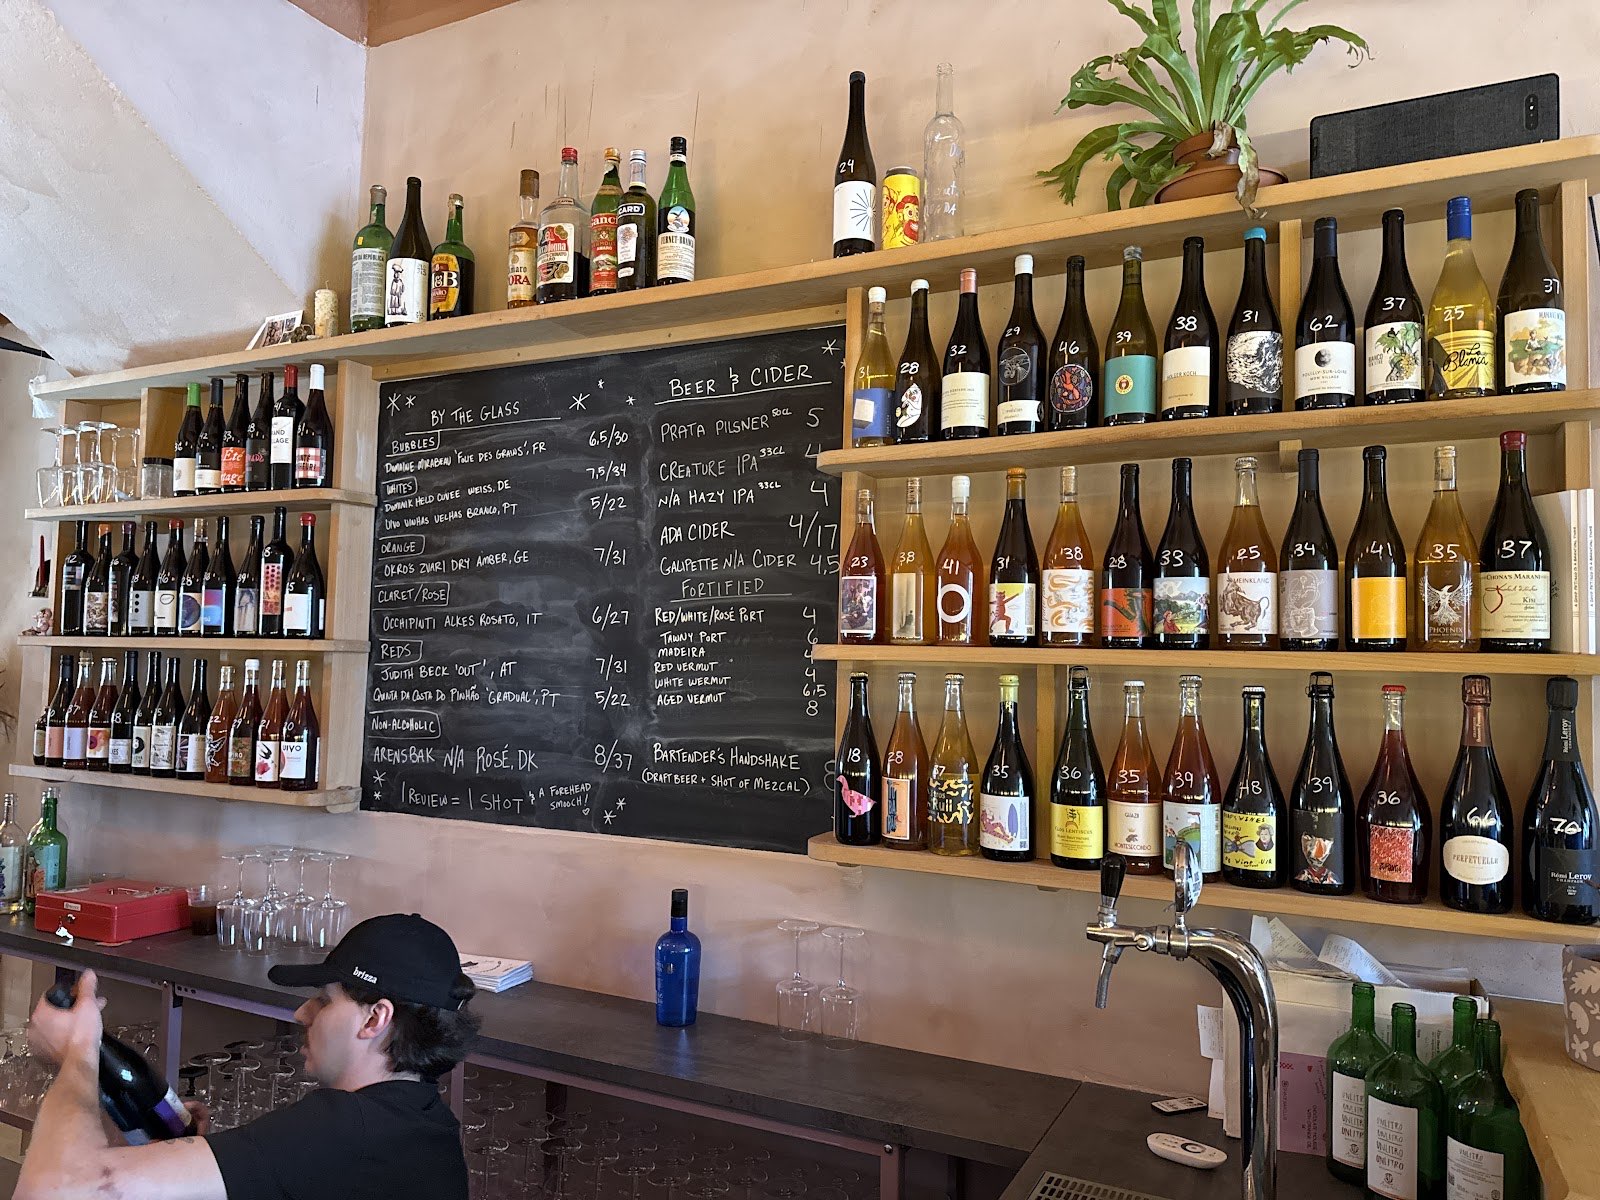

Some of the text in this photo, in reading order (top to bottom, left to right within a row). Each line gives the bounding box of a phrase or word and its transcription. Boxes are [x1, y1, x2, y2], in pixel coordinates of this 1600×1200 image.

[840, 159, 854, 173] 24
[619, 205, 640, 214] CARD
[1543, 278, 1559, 294] 37
[1382, 297, 1406, 310] 37
[1242, 310, 1259, 323] 31
[1444, 306, 1464, 321] 25
[1175, 316, 1197, 331] 38
[1310, 315, 1338, 331] 62
[1005, 327, 1020, 337] 29
[1116, 331, 1132, 343] 39
[950, 345, 967, 356] 32
[1058, 341, 1080, 355] 46
[900, 362, 919, 374] 28
[1443, 351, 1488, 372] Blanca
[669, 365, 812, 396] BEER CIDER
[431, 401, 520, 427] BY THE GLASS
[806, 408, 824, 427] 5
[661, 414, 769, 442] PRATA PILSNER
[392, 436, 435, 454] BUBBLES
[478, 452, 493, 462] DES
[533, 442, 547, 455] FR
[660, 446, 785, 481] CREATURE IPA 33CL
[387, 481, 413, 495] WHITES
[416, 493, 434, 506] HELD
[437, 489, 460, 501] CUVEE
[498, 480, 511, 491] DE
[658, 481, 781, 508] N/A HAZY IPA 33CL
[810, 480, 828, 506] 4
[502, 502, 518, 515] PT
[590, 493, 627, 519] 5/22
[661, 521, 735, 546] ADA CIDER
[789, 511, 837, 549] 4/17
[381, 541, 416, 554] ORANGE
[594, 541, 626, 566] 7/31
[1237, 546, 1260, 560] 25
[1294, 542, 1316, 556] 34
[1371, 541, 1392, 560] 41
[1430, 544, 1460, 559] 35
[1500, 540, 1532, 559] 37
[452, 557, 470, 570] DRY
[514, 550, 529, 564] GE
[660, 549, 797, 576] GALIPETTE N/A CIDER
[851, 556, 869, 568] 23
[1109, 554, 1127, 569] 28
[1160, 550, 1183, 567] 33
[943, 559, 960, 575] 41
[682, 578, 764, 598] FORTIFIED
[444, 613, 474, 627] ALKES
[526, 612, 543, 624] IT
[592, 604, 629, 631] 6/27
[739, 607, 764, 623] PORT
[803, 607, 816, 624] 4
[661, 632, 727, 643] TAWNY PORT
[808, 629, 818, 644] 6
[381, 643, 411, 659] REDS
[658, 647, 705, 658] MADEIRA
[381, 661, 517, 681] JUDITH BECK AT
[596, 655, 627, 681] 7/31
[654, 662, 719, 674] RED VERMUT
[805, 667, 816, 682] 4
[655, 676, 731, 689] WHITE WERMUT
[401, 690, 411, 700] DA
[436, 690, 446, 701] DO
[541, 689, 560, 707] PT
[595, 686, 630, 710] 5/22
[657, 692, 726, 706] AGED VERMUT
[806, 700, 818, 716] 8
[371, 717, 436, 733] NON-ALCOHOLIC
[373, 746, 435, 764] ARENSBAK
[443, 745, 464, 774] N/A
[519, 749, 538, 771] DK
[595, 739, 633, 773] 8/37
[653, 742, 801, 770] BARTENDER'S HANDSHAKE
[847, 748, 861, 763] 18
[888, 751, 903, 764] 28
[993, 765, 1009, 779] 35
[1059, 765, 1082, 780] 36
[1118, 769, 1141, 784] 35
[1174, 771, 1195, 789] 39
[550, 782, 592, 797] FOREHEAD
[674, 774, 698, 784] BEER
[711, 775, 736, 788] SHOT
[739, 779, 751, 789] OF
[1311, 777, 1334, 793] 39
[408, 789, 523, 813] REVIEW SHOT
[1378, 791, 1400, 805] 36
[1453, 854, 1499, 864] PERPETUELLE
[1569, 872, 1592, 880] Leroy
[353, 966, 377, 984] brizza
[1376, 1154, 1404, 1171] UNLITRO
